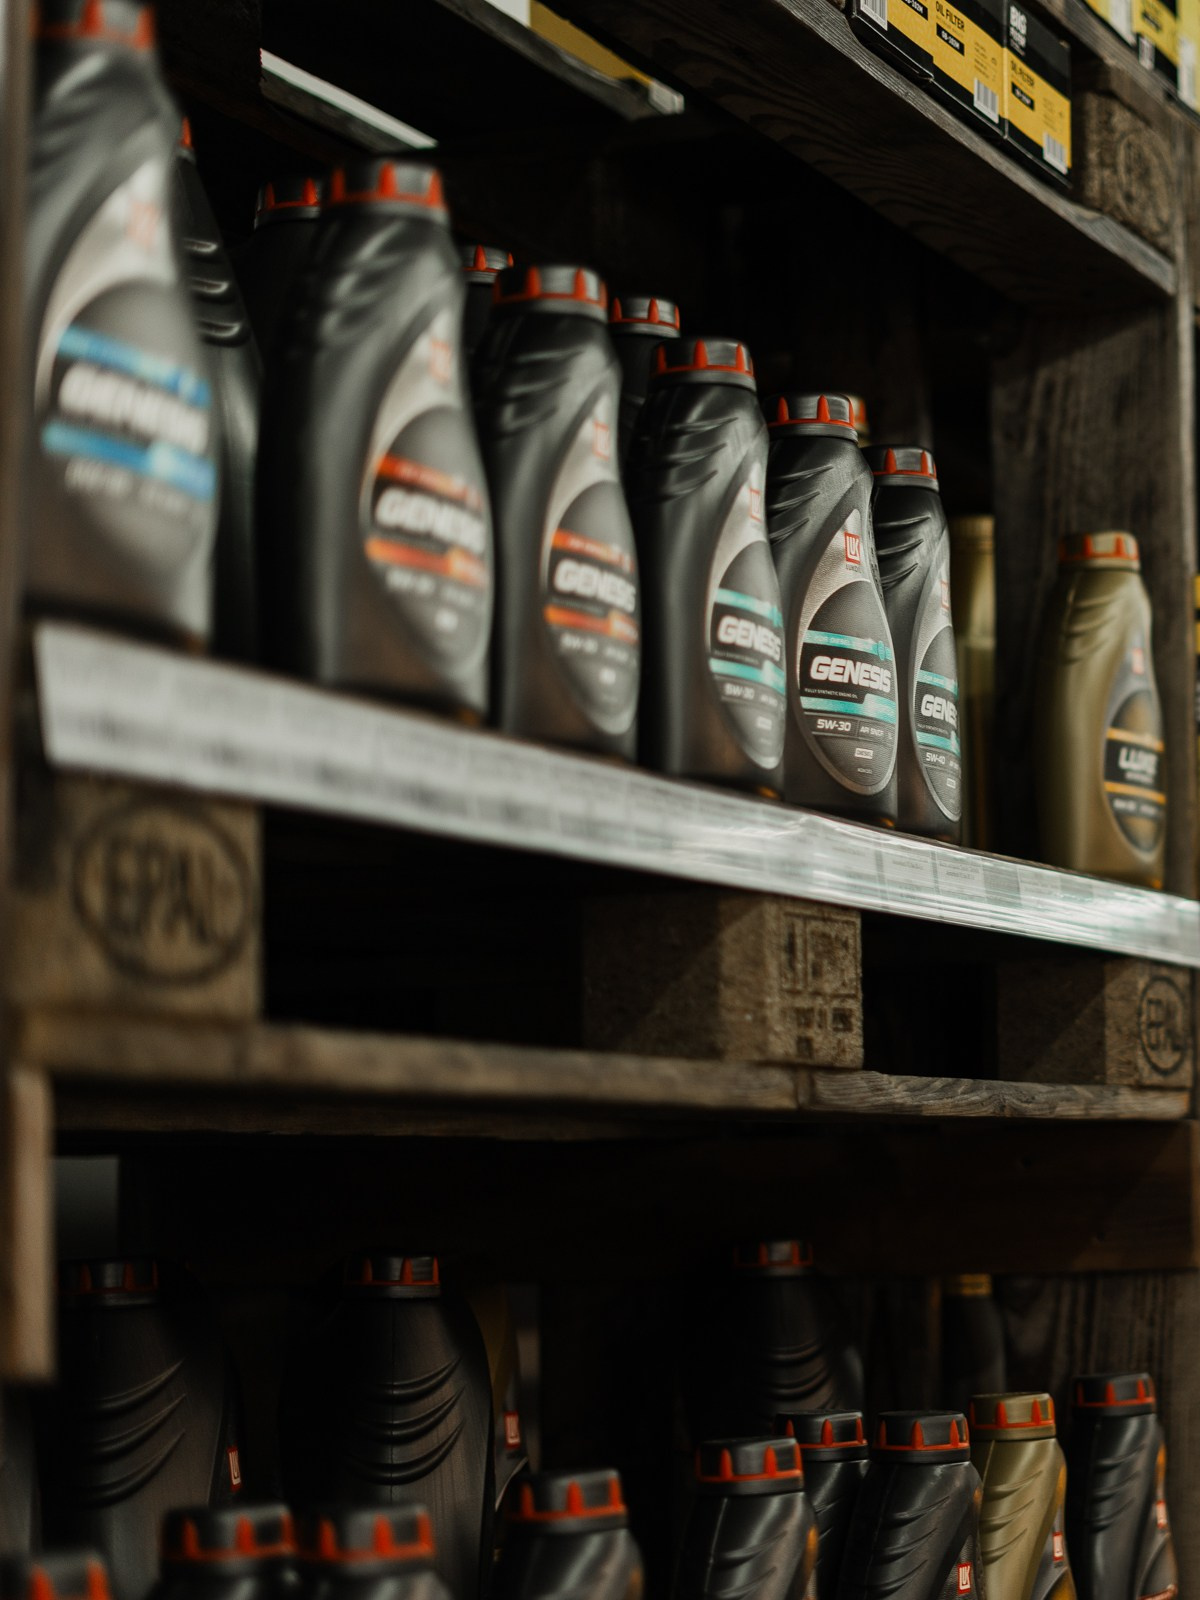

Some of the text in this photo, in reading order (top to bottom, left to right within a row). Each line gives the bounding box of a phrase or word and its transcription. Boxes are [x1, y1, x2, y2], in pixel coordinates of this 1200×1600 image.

[935, 1, 965, 30] OIL FILTER
[810, 655, 892, 693] GENESIS
[817, 689, 839, 697] SYNTHETIC
[816, 718, 852, 732] 5W-30
[925, 751, 946, 765] 5W-40
